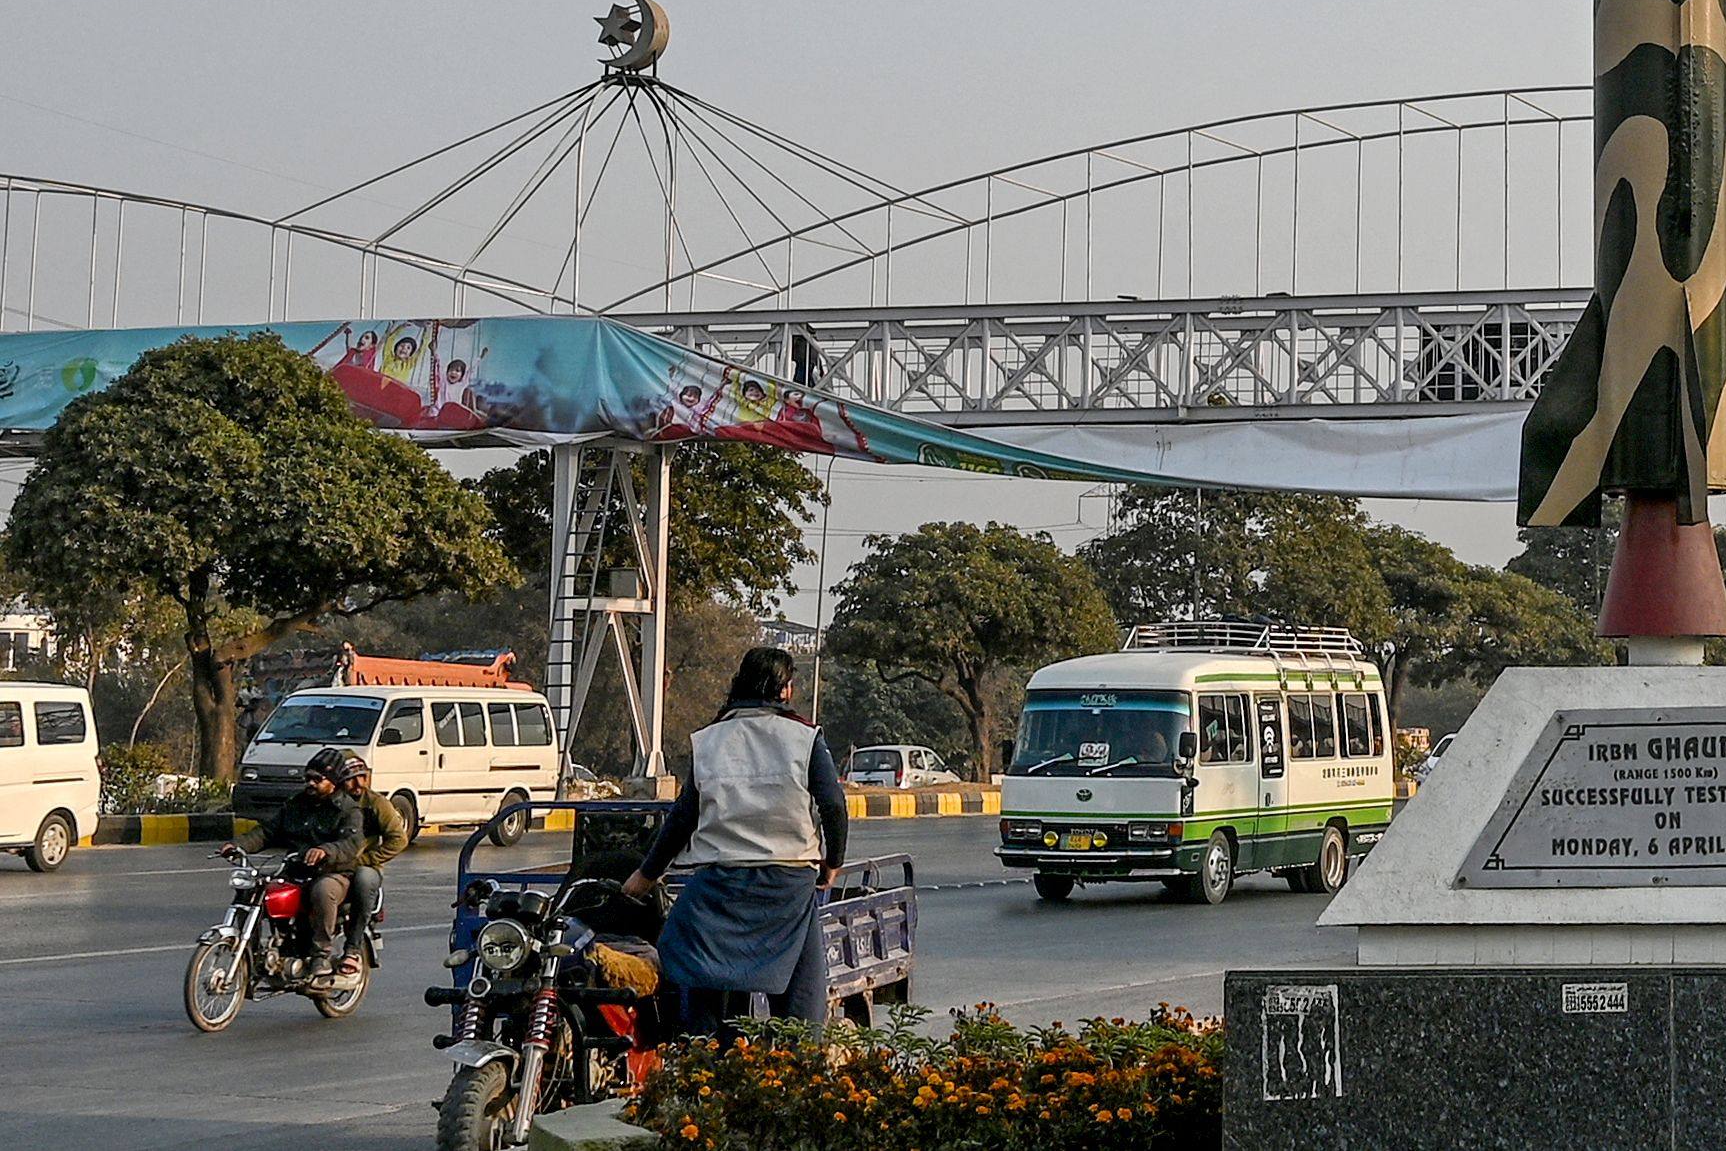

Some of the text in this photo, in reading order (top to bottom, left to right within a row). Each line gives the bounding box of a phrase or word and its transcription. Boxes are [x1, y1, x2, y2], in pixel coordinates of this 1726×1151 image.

[1588, 743, 1638, 763] IRBM
[1612, 768, 1659, 782] (RANGE
[1663, 767, 1692, 780] 1500
[1540, 785, 1676, 808] SUCCESSFULLY
[1654, 811, 1681, 830] ON
[1551, 837, 1639, 858] MONDAY,
[1647, 837, 1659, 856] 6
